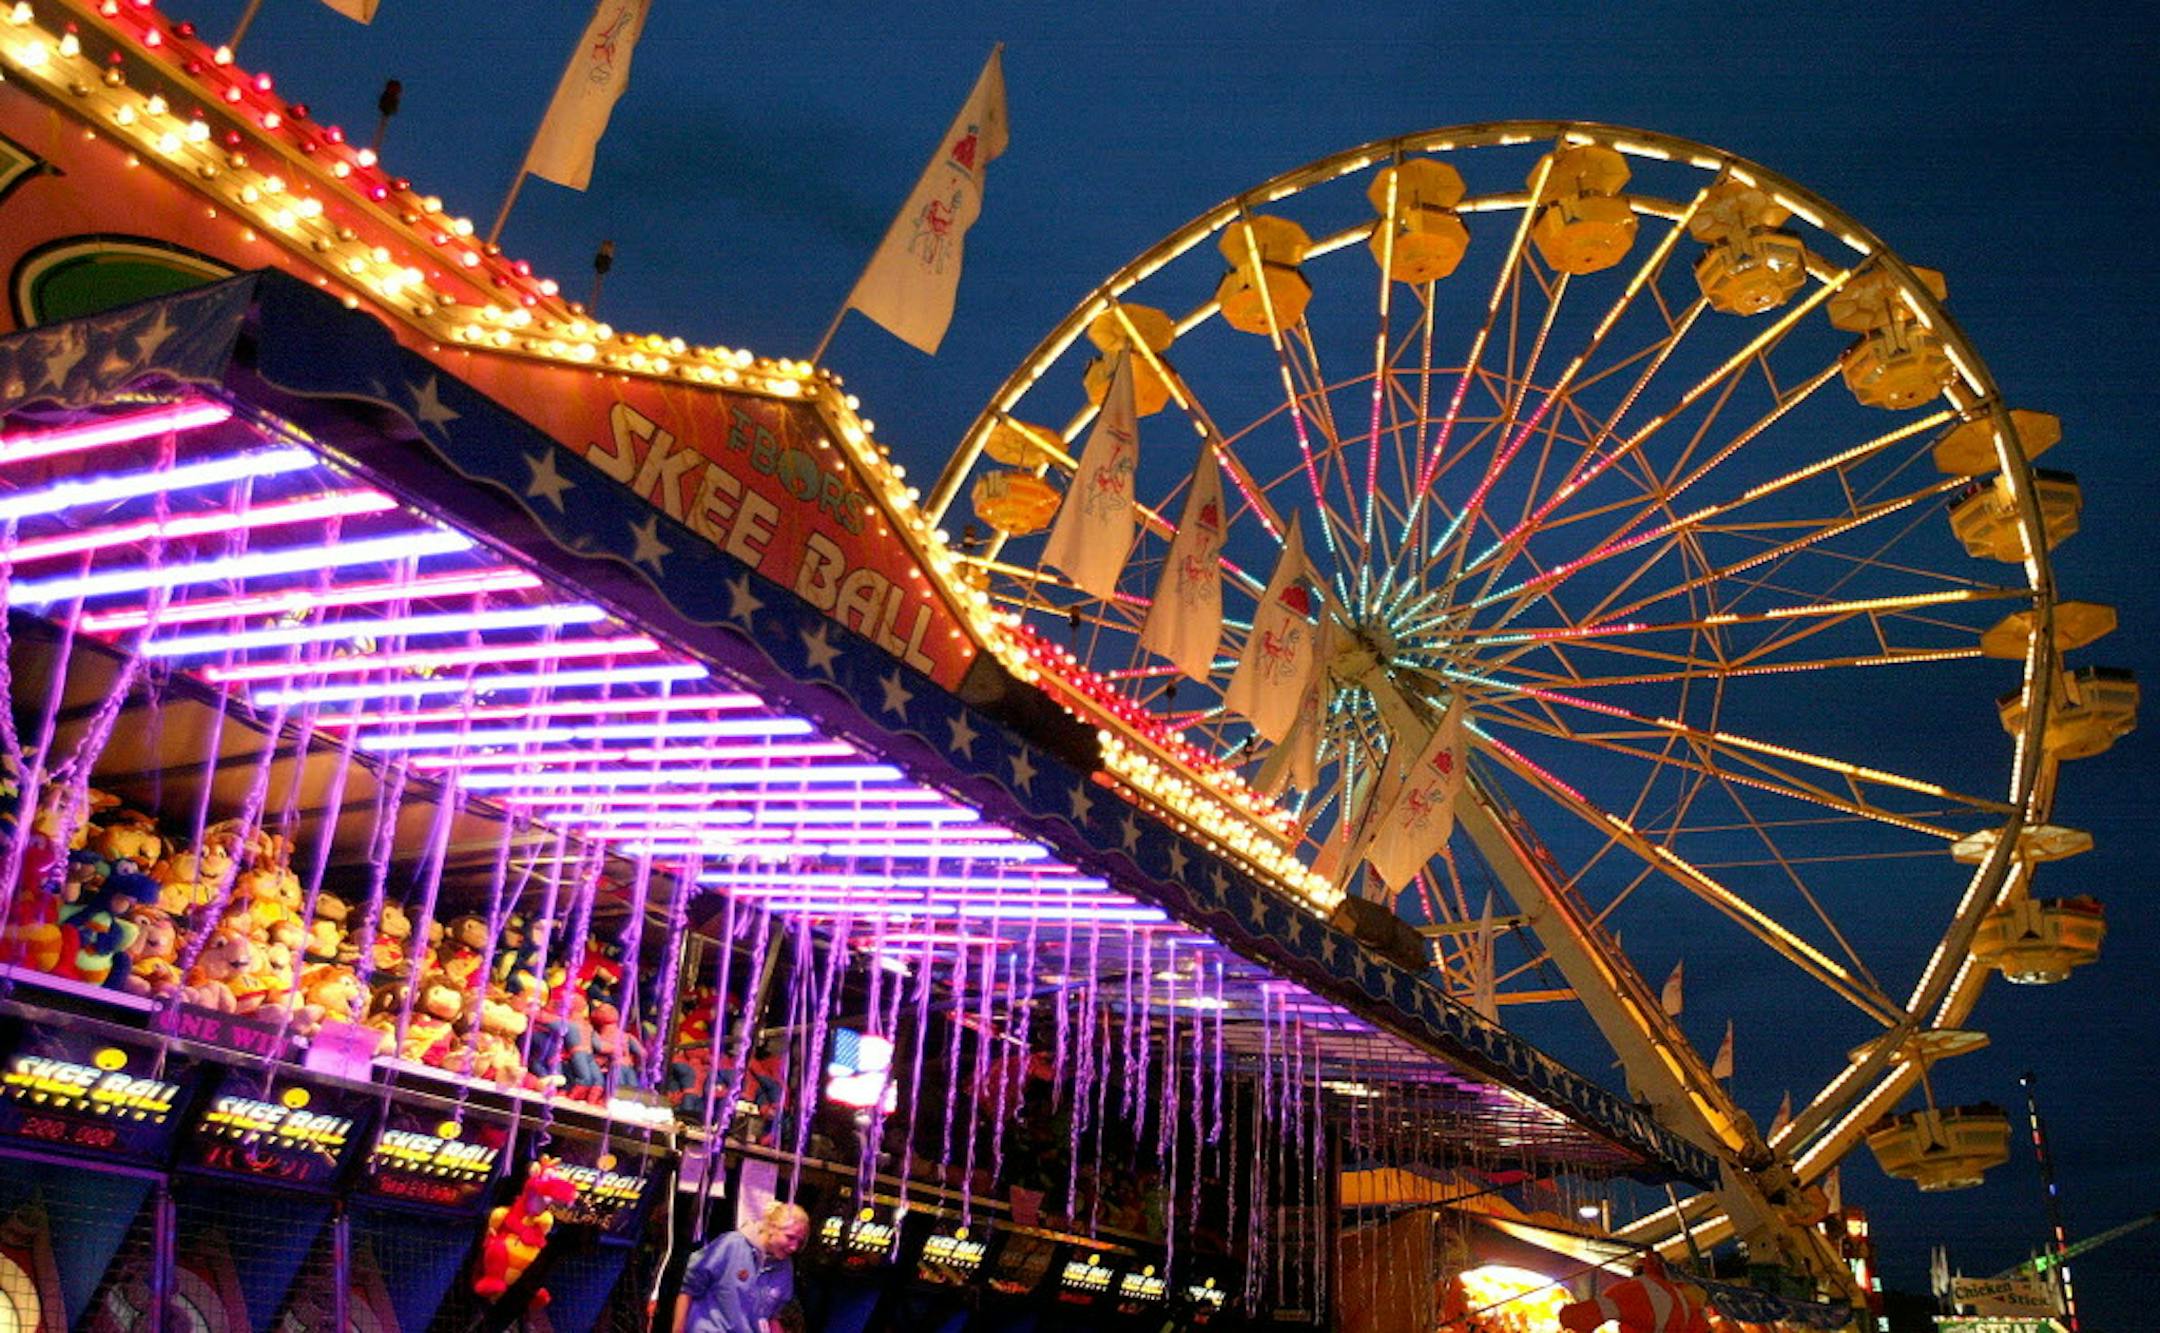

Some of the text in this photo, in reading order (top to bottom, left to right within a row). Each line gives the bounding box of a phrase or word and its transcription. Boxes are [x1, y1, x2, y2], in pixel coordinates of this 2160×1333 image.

[587, 402, 935, 676] SKEE BALL
[158, 1009, 221, 1042] ONE
[4, 1056, 102, 1098] SKEE
[90, 1072, 180, 1112] BALL
[206, 1096, 290, 1131] SKEE
[279, 1110, 353, 1144] BALL
[376, 1129, 444, 1163] SKEE
[434, 1140, 499, 1172] BALL
[593, 1172, 648, 1199] BALL
